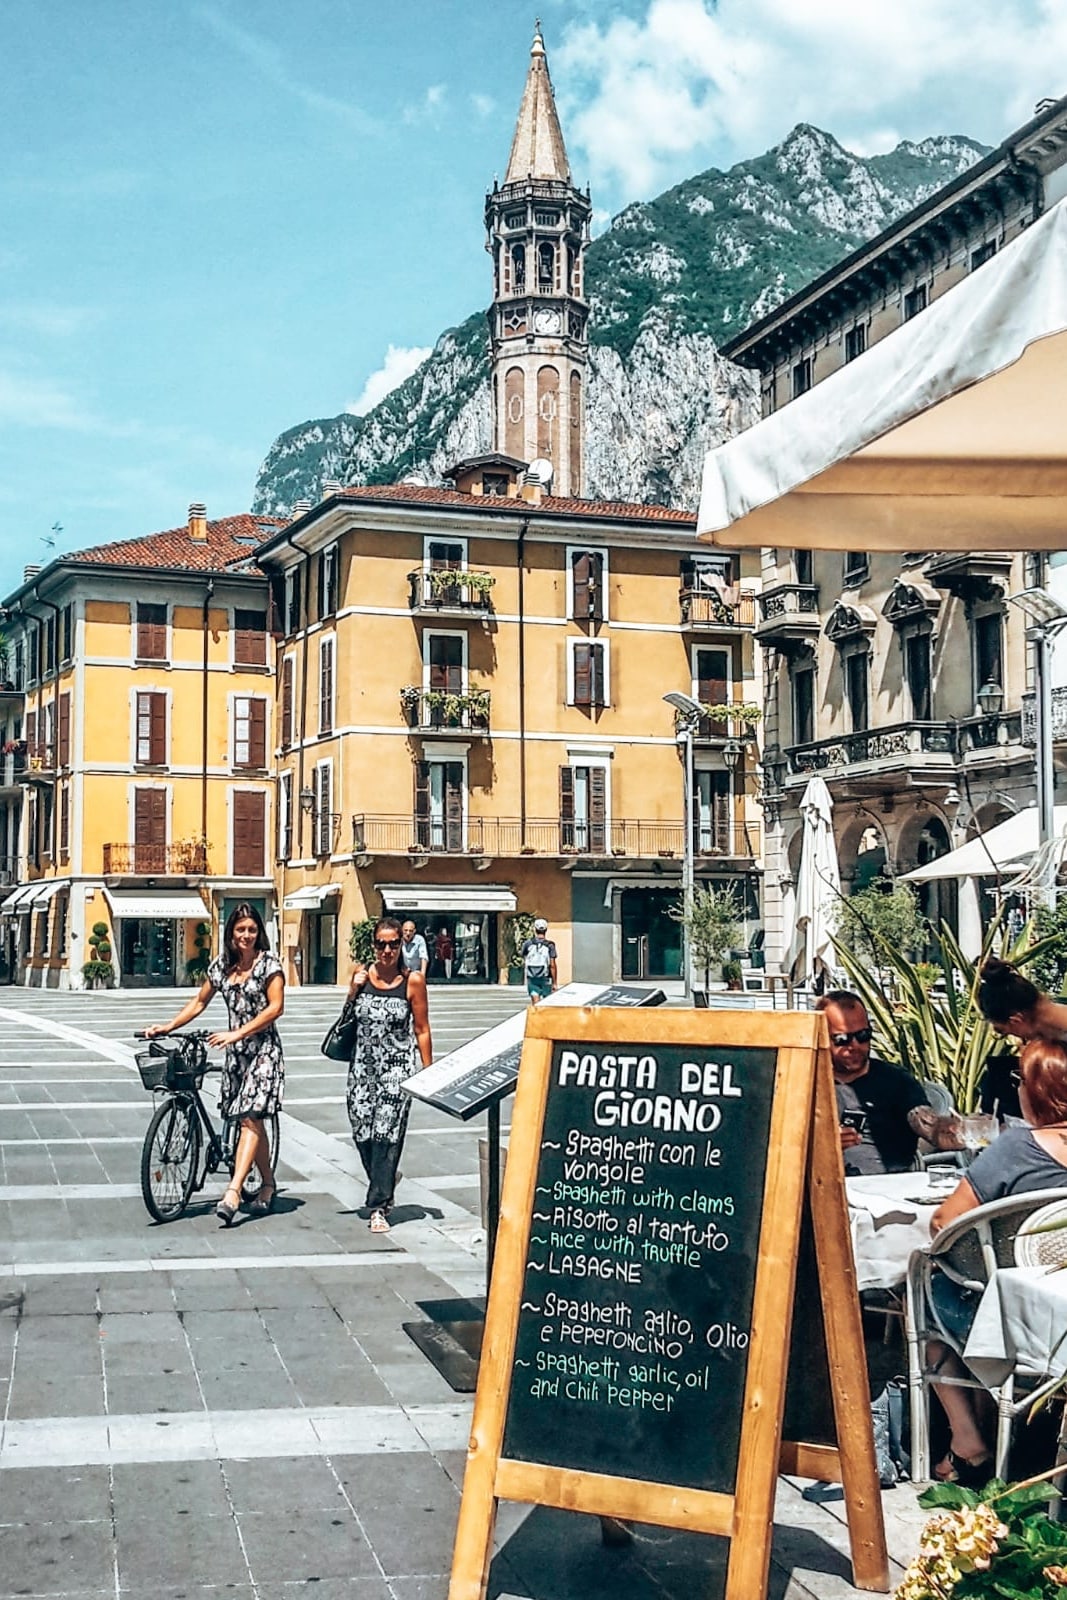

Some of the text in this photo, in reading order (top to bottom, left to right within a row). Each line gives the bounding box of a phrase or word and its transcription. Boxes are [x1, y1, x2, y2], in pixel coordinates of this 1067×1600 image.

[558, 1051, 657, 1089] PASTA
[681, 1062, 742, 1097] DEL
[566, 1129, 721, 1167] Spaghetti con le
[553, 1181, 735, 1216] Spaghetti with clams
[594, 1235, 635, 1256] with
[627, 1214, 643, 1235] al
[649, 1217, 729, 1251] tartufo
[549, 1252, 643, 1283] LASAGNE
[543, 1292, 632, 1328] Spaghetti
[540, 1324, 553, 1342] e
[536, 1351, 620, 1382] Spaghetti
[685, 1366, 709, 1391] oil
[530, 1377, 559, 1398] and
[608, 1384, 674, 1412] pepper
